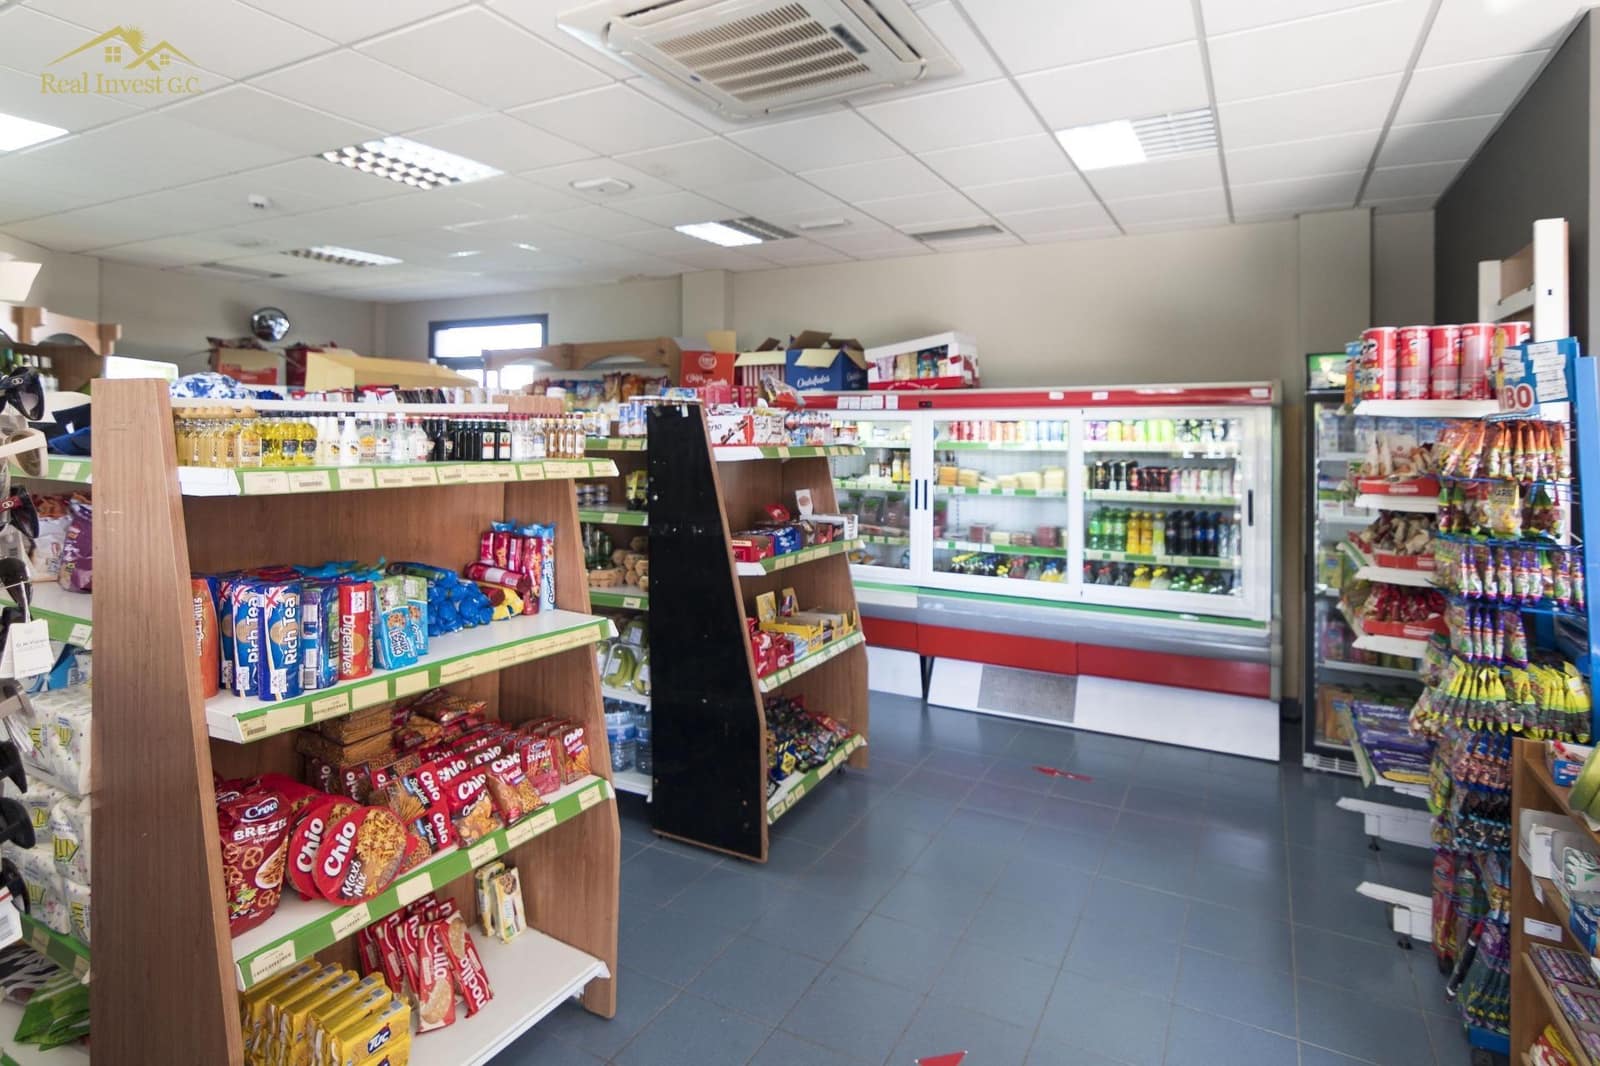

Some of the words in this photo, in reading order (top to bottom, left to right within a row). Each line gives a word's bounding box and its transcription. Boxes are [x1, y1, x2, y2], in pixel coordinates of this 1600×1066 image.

[247, 597, 259, 625] Tea
[283, 596, 297, 627] Tea
[284, 629, 298, 665] Rich
[339, 614, 356, 675] Digestives
[420, 771, 441, 801] Chio
[457, 773, 487, 800] Chio
[432, 812, 448, 844] Chio
[296, 817, 324, 873] Chio
[323, 821, 357, 877] Chio
[341, 859, 362, 897] Maxi
[353, 872, 368, 897] Mix
[368, 1031, 391, 1054] TUC
